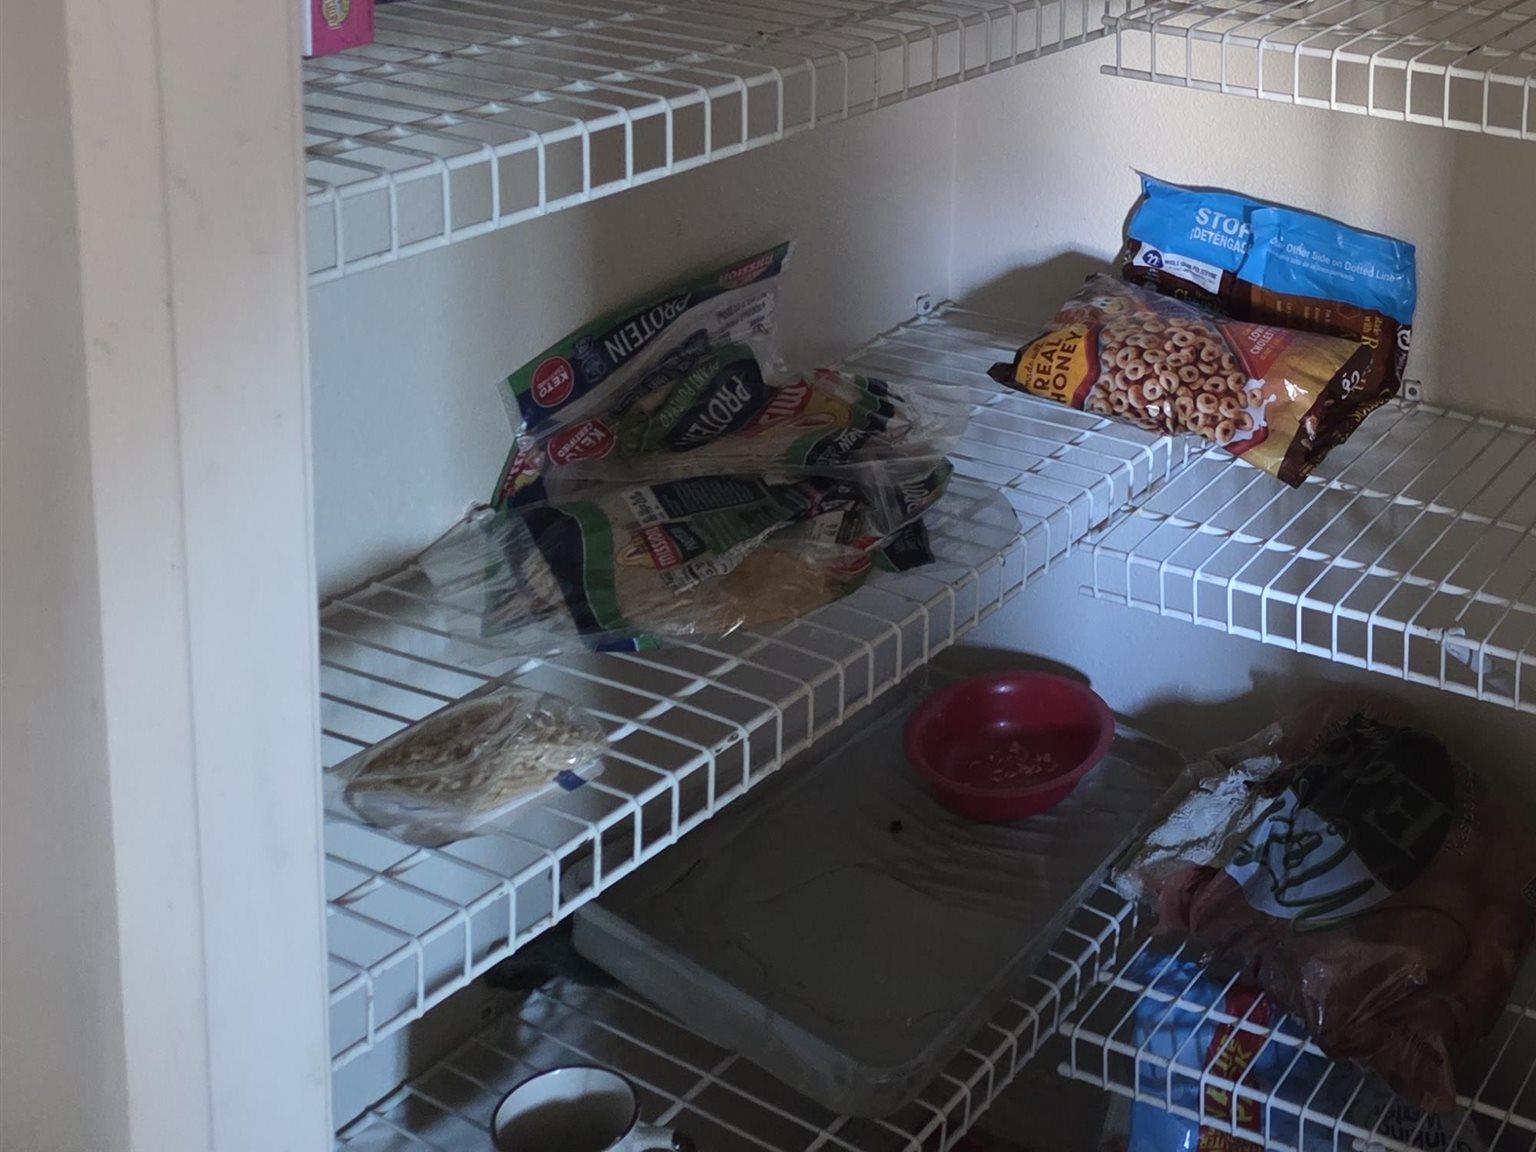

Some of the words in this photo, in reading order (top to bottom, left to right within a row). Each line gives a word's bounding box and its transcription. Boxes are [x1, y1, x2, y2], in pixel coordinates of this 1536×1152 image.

[1343, 258, 1374, 279] Dotted
[605, 292, 692, 362] PROTEIN
[537, 365, 571, 397] KETO
[1033, 337, 1063, 391] REAL
[1052, 330, 1084, 404] HONEY
